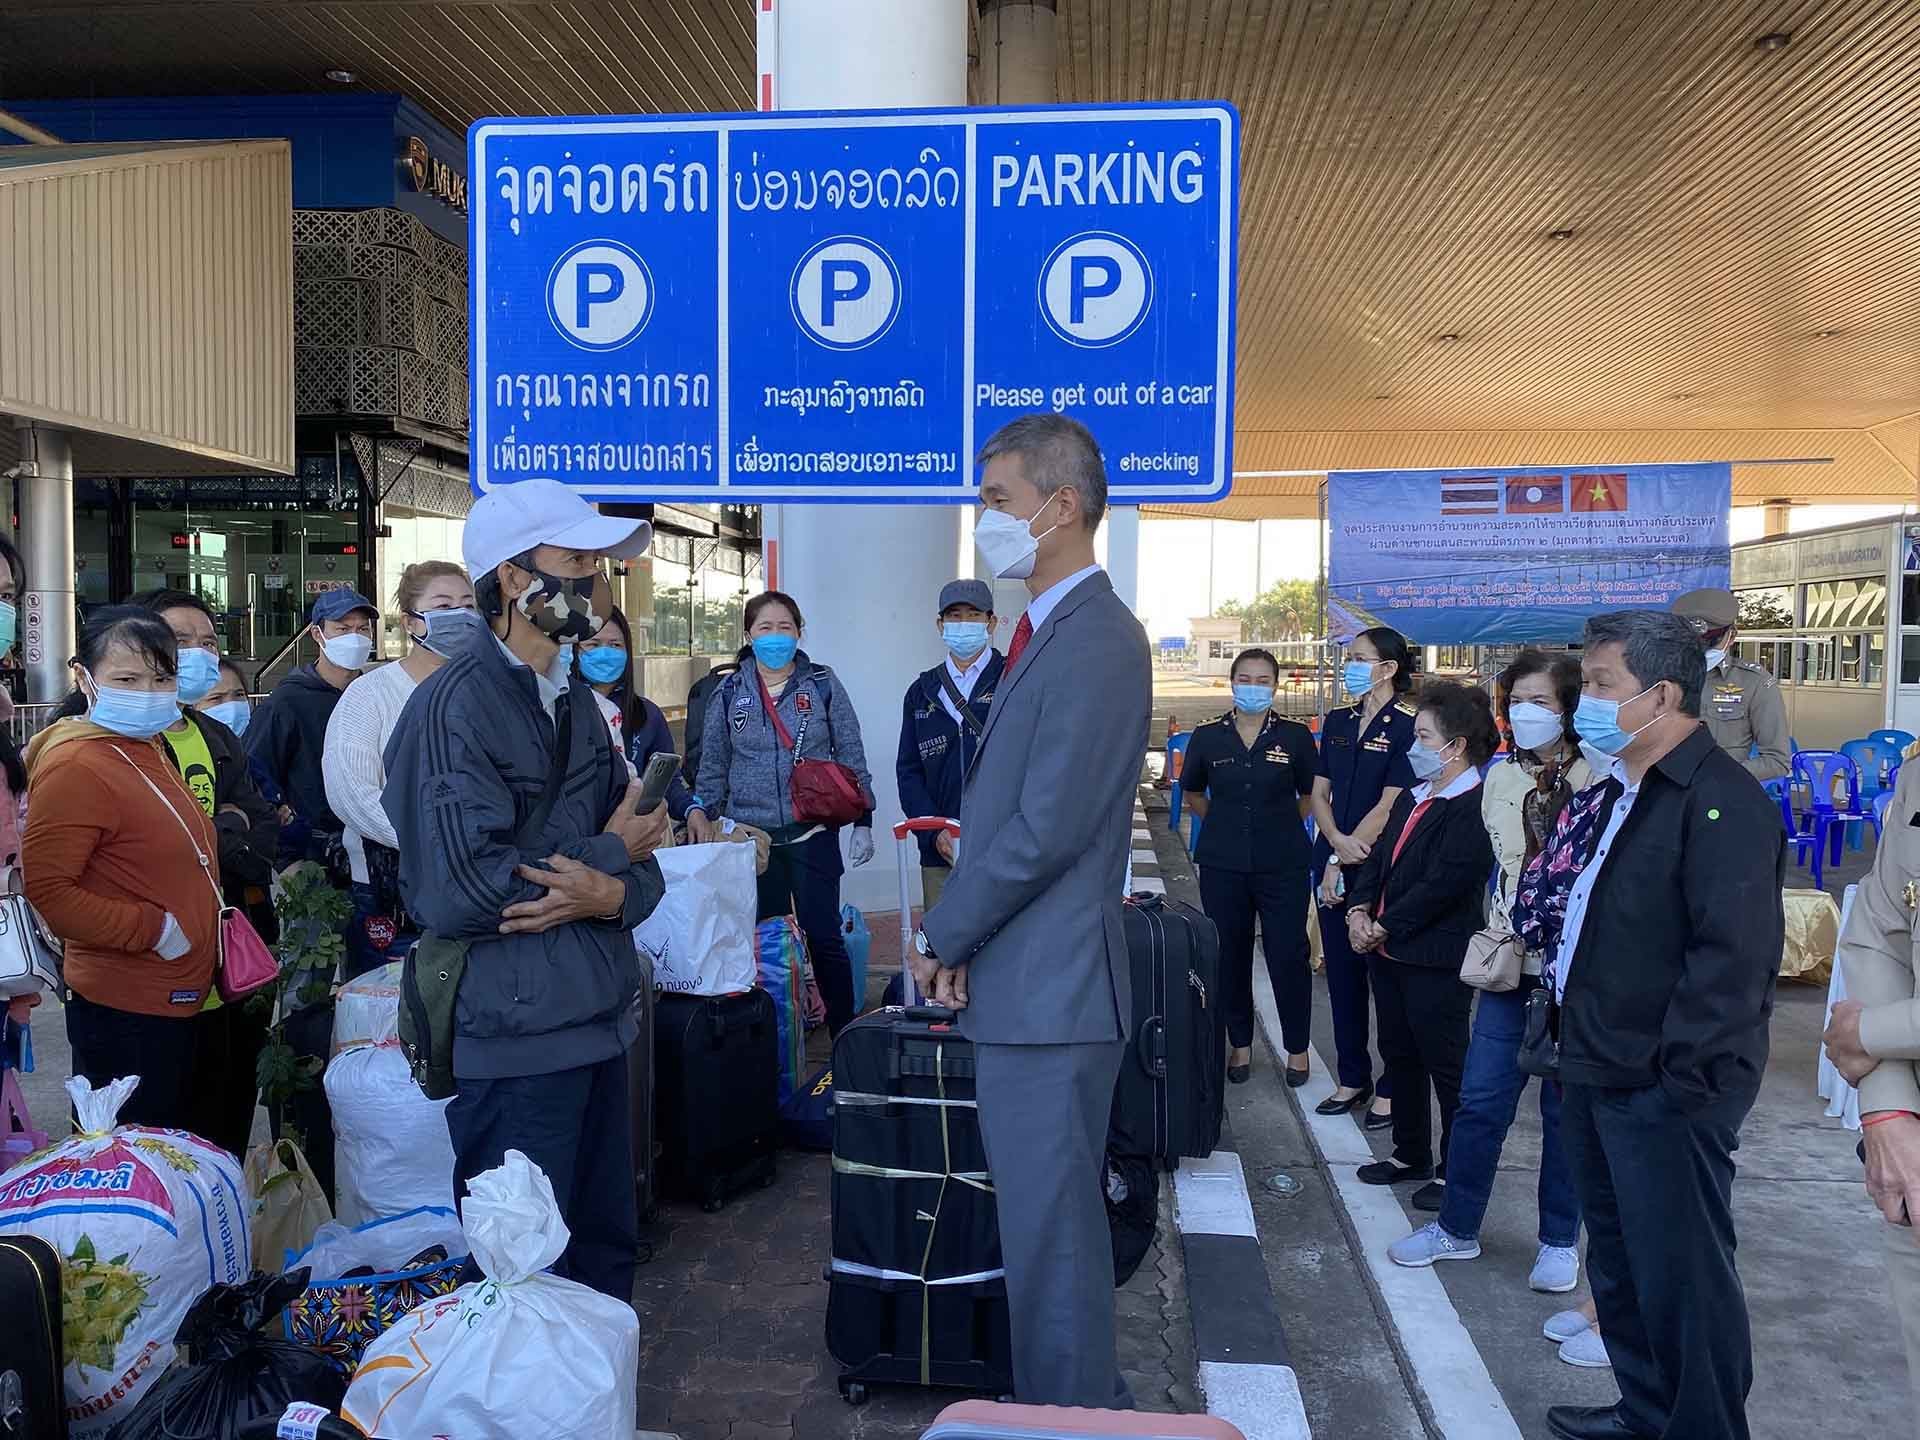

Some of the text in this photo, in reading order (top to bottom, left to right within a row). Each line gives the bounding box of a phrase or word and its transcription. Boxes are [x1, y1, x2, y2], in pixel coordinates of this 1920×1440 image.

[495, 161, 709, 236] จุดจอดรถ
[991, 150, 1204, 207] PARKING
[576, 263, 625, 328] P
[821, 260, 871, 326] P
[1069, 256, 1122, 324] P
[495, 374, 710, 421] กรุณาลงจากรถ
[976, 381, 1213, 413] Please get out of a car
[493, 424, 712, 472] เพื่อตรวจสอบเอกสาร
[1120, 451, 1199, 476] checking
[666, 975, 703, 991] nuovo
